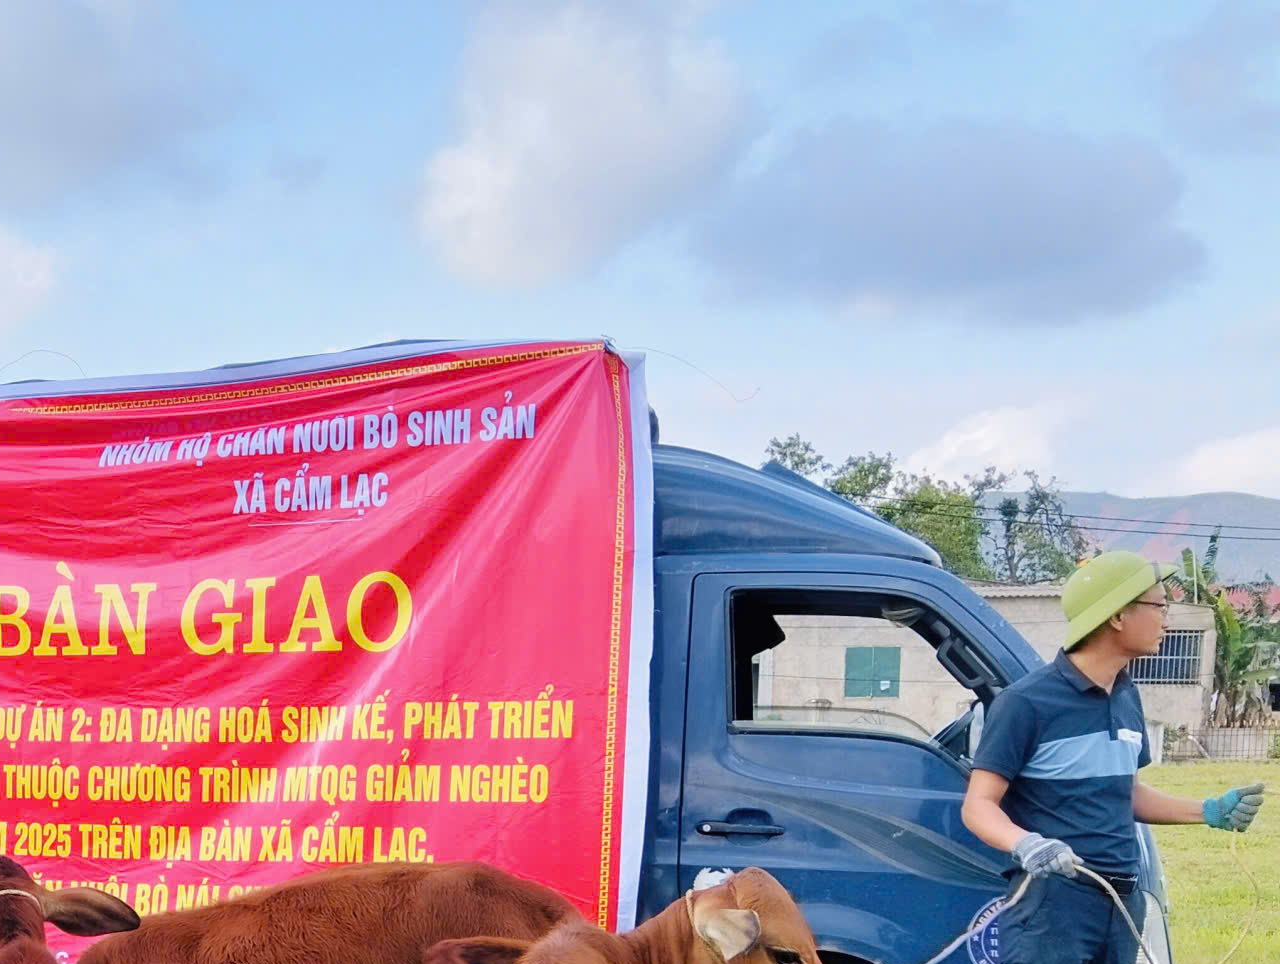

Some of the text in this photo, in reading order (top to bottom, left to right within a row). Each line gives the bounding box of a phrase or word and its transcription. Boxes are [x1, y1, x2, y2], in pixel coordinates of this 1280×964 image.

[98, 437, 173, 467] NHÓM
[363, 405, 398, 449] BÒ
[406, 408, 471, 447] SINH
[479, 391, 536, 442] SẢN
[234, 463, 389, 515] XÃ CẨM LẠC
[180, 570, 413, 656] GIAO
[28, 700, 64, 742] ÁN
[70, 707, 93, 742] 2:
[99, 707, 133, 743] ĐA
[140, 707, 211, 751] DẠNG
[219, 699, 273, 743] HOÁ
[281, 705, 347, 743] SINH
[351, 690, 394, 744] KẾ,
[403, 693, 479, 740] PHÁT
[487, 684, 574, 739] TRIỂN
[3, 757, 80, 807] THUỘC
[87, 762, 191, 802] CHƯƠNG
[199, 759, 278, 804] TRÌNH
[282, 764, 357, 806] MTQG
[365, 748, 441, 802] GIẢM
[449, 756, 549, 803] NGHÈO
[14, 822, 71, 858] 2025
[78, 817, 142, 860] TRÊN
[149, 825, 192, 869] ĐỊA
[199, 819, 253, 862] BÀN
[258, 819, 294, 862] XÃ
[301, 811, 364, 863] CẨM
[134, 875, 169, 918] BÒ
